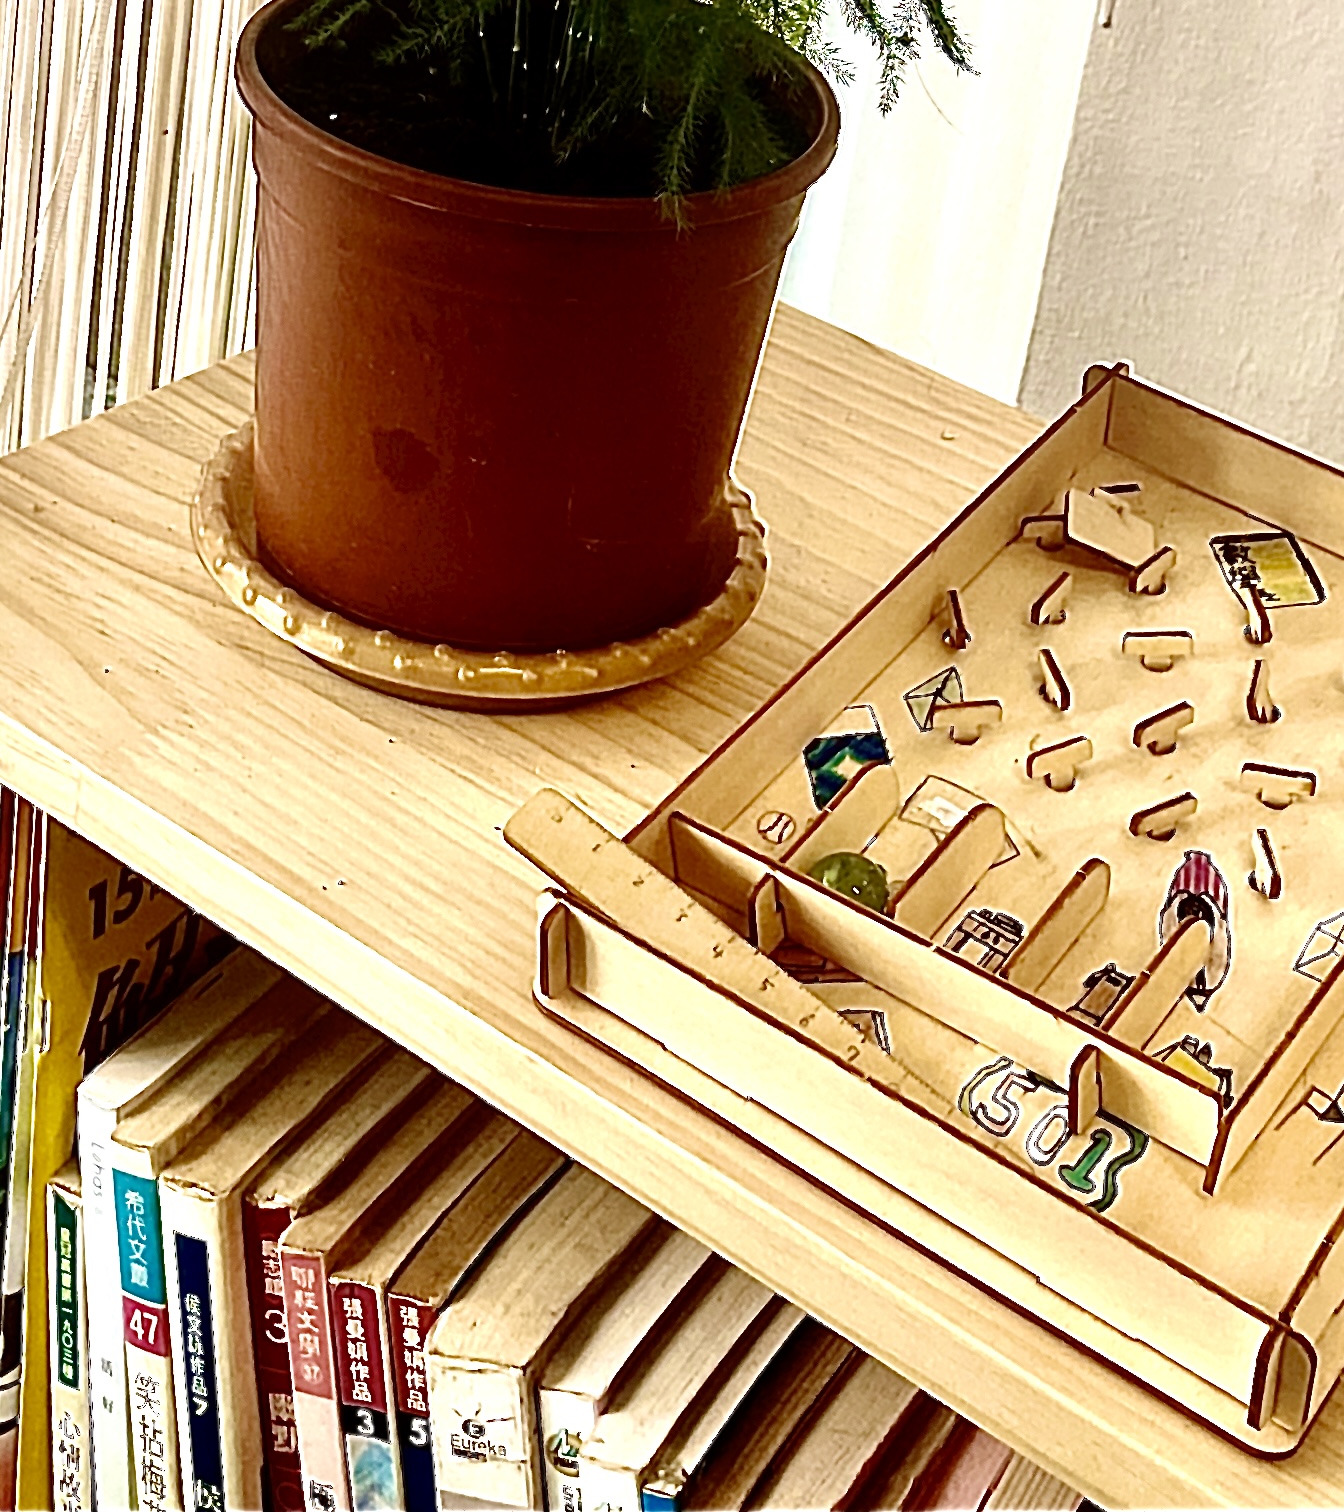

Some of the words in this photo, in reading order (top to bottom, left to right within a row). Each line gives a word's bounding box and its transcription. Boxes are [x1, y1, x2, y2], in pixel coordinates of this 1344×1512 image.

[87, 866, 163, 940] 15
[129, 1308, 158, 1345] 47
[343, 1297, 373, 1403] 張曼娟作品
[399, 1304, 428, 1413] 張曼娟作品
[133, 1370, 169, 1512] 笑拈梅
[356, 1408, 376, 1436] 3
[408, 1417, 428, 1446] 5
